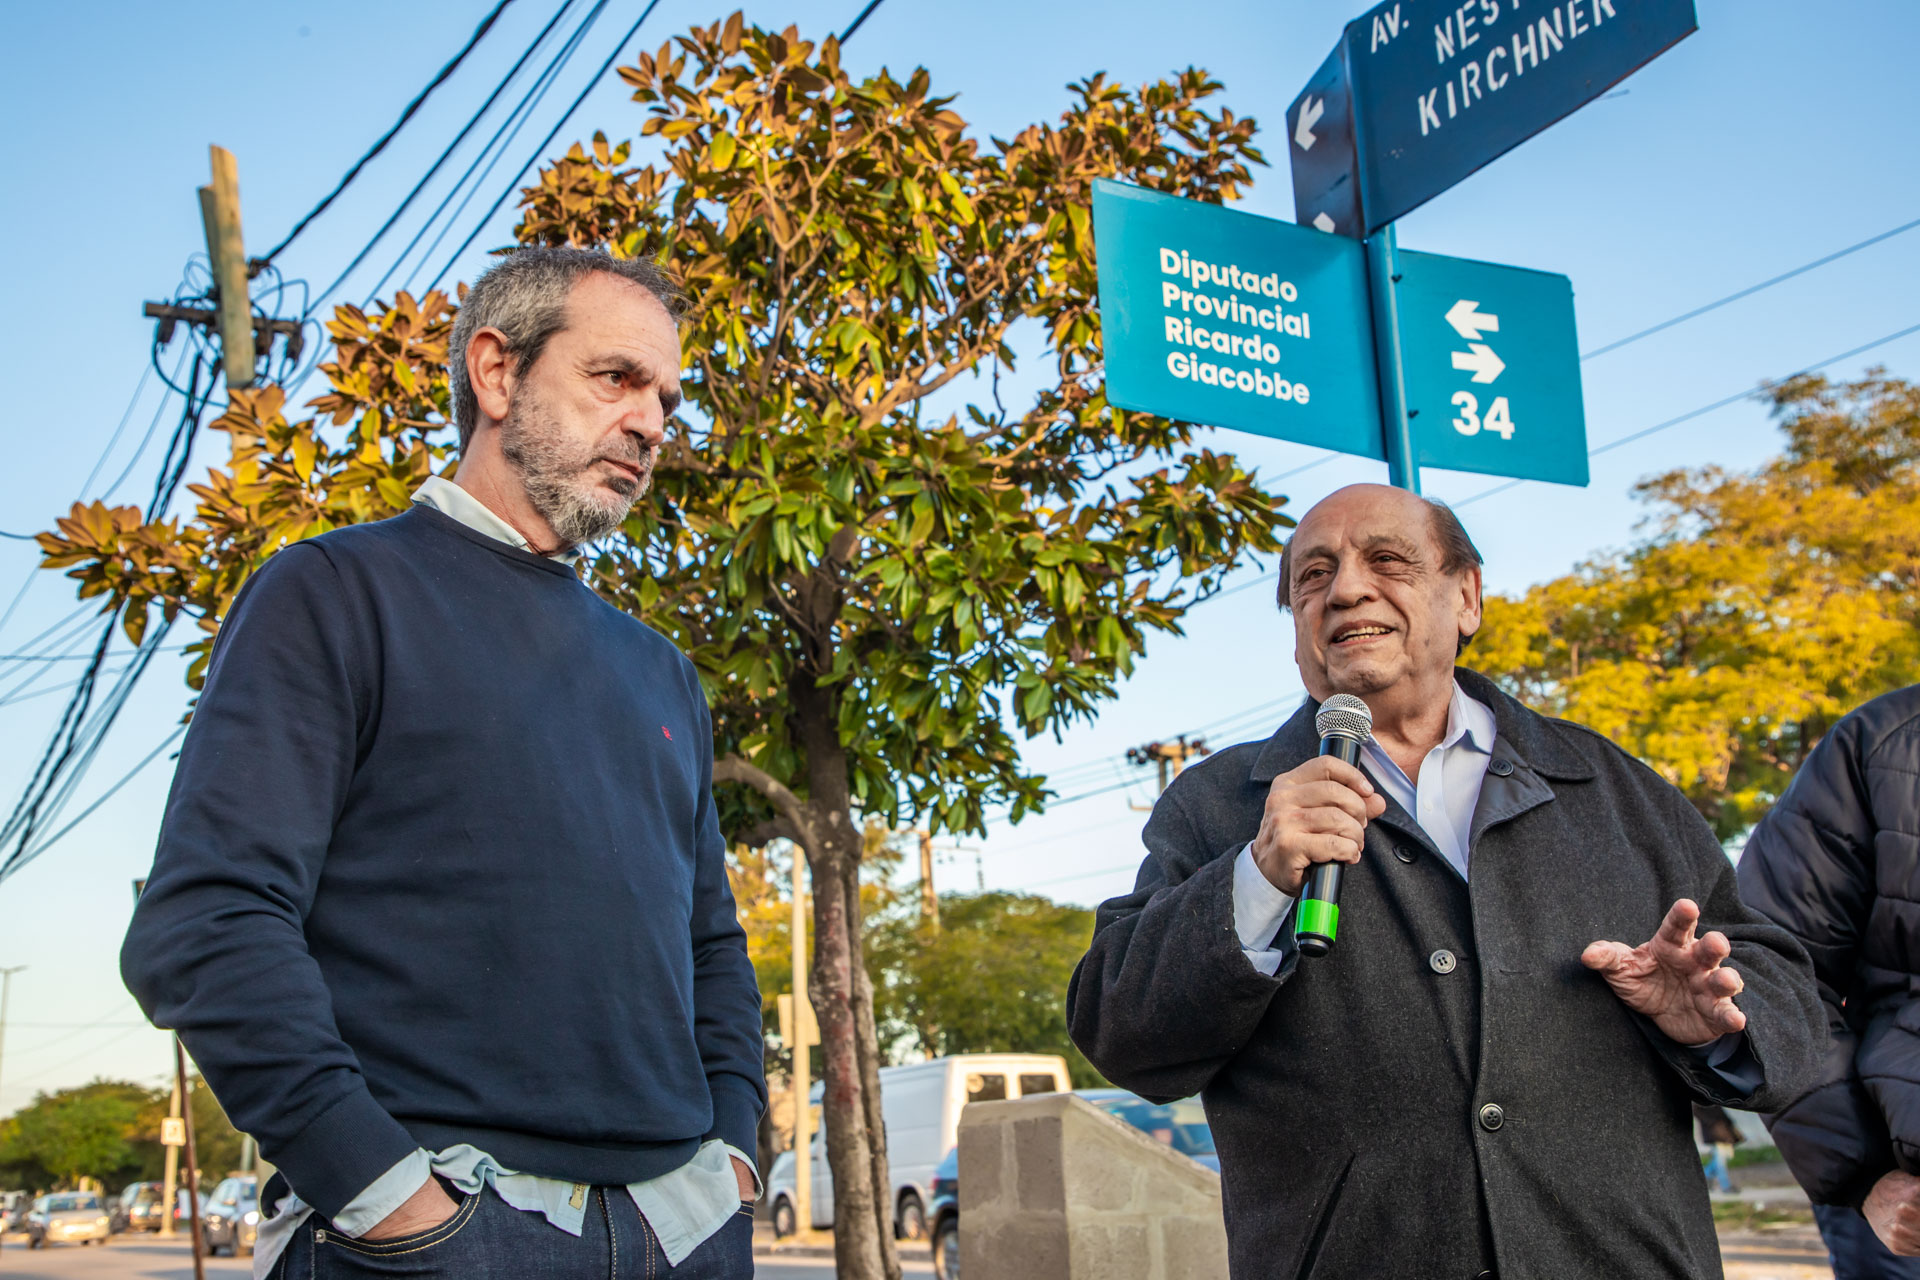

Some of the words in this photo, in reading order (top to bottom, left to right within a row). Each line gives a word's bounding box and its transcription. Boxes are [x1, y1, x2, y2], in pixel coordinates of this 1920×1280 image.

[1371, 4, 1410, 54] AV.
[1434, 0, 1520, 64] NES
[1417, 0, 1616, 136] KIRCHNER
[1159, 247, 1298, 302] Diputado
[1162, 281, 1311, 339] Provincial
[1164, 315, 1281, 365] Ricardo
[1166, 351, 1310, 405] Giacobbe
[1451, 390, 1515, 440] 34
